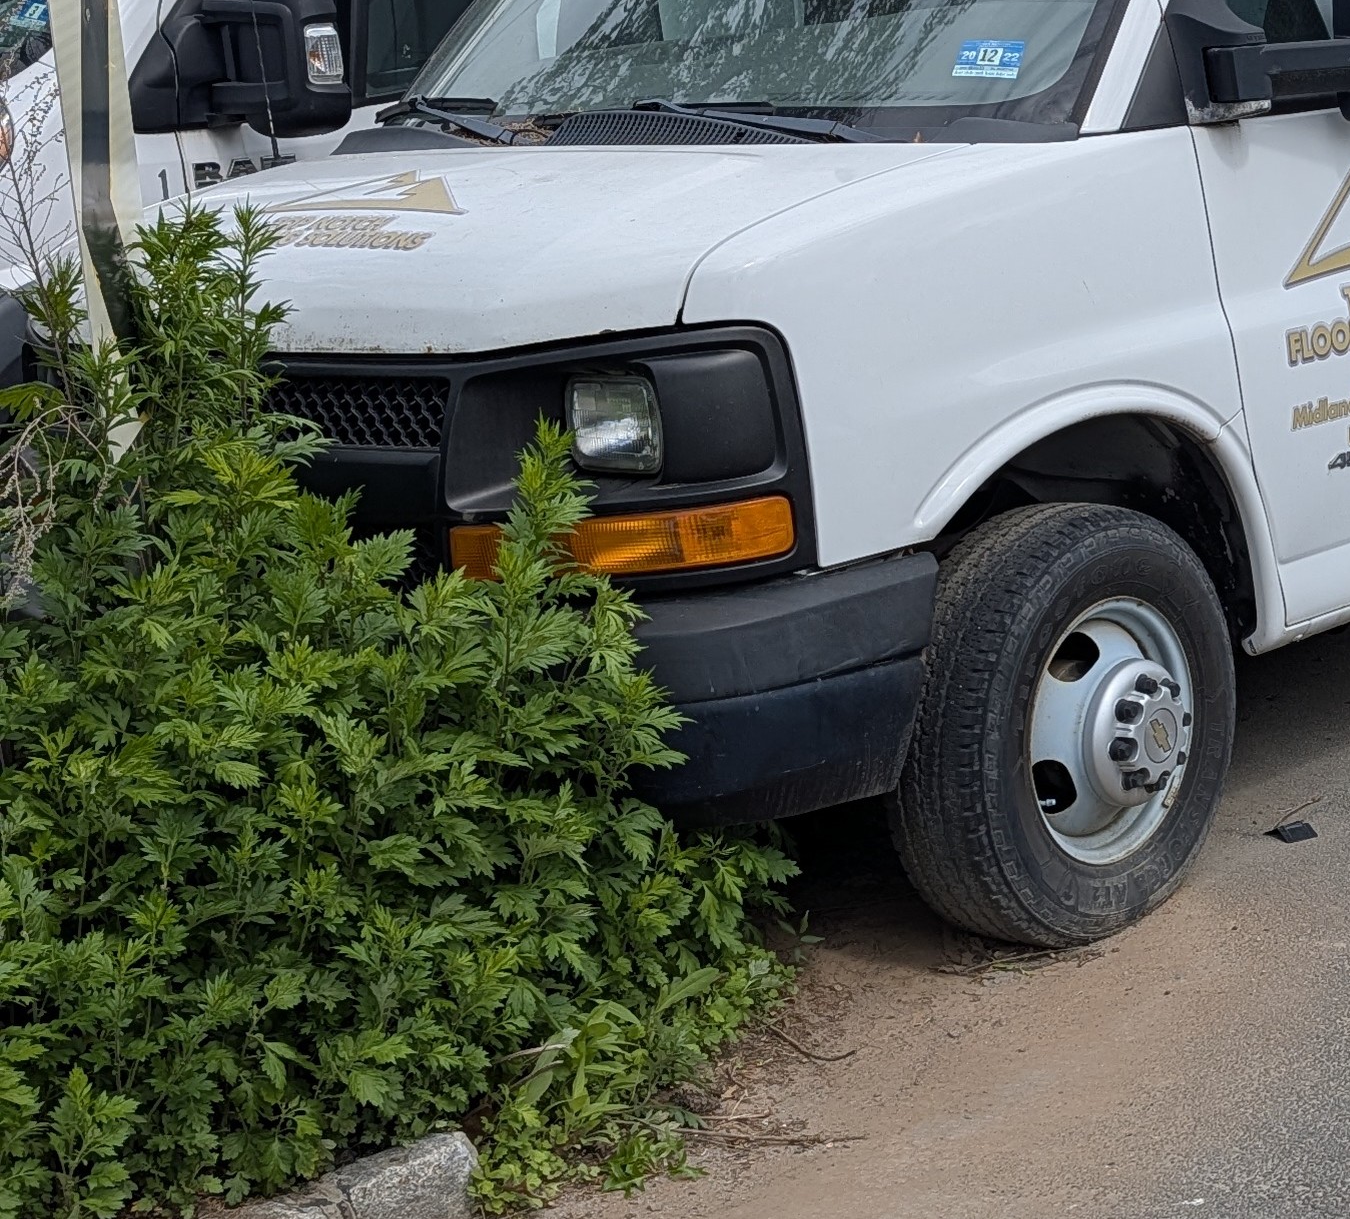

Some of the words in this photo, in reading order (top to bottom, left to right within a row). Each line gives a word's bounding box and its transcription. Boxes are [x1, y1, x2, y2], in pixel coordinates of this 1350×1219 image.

[961, 50, 977, 60] 20
[979, 48, 999, 63] 12
[1002, 52, 1020, 62] 22
[305, 215, 399, 231] NOTCH
[294, 230, 435, 251] SOLUTIONS
